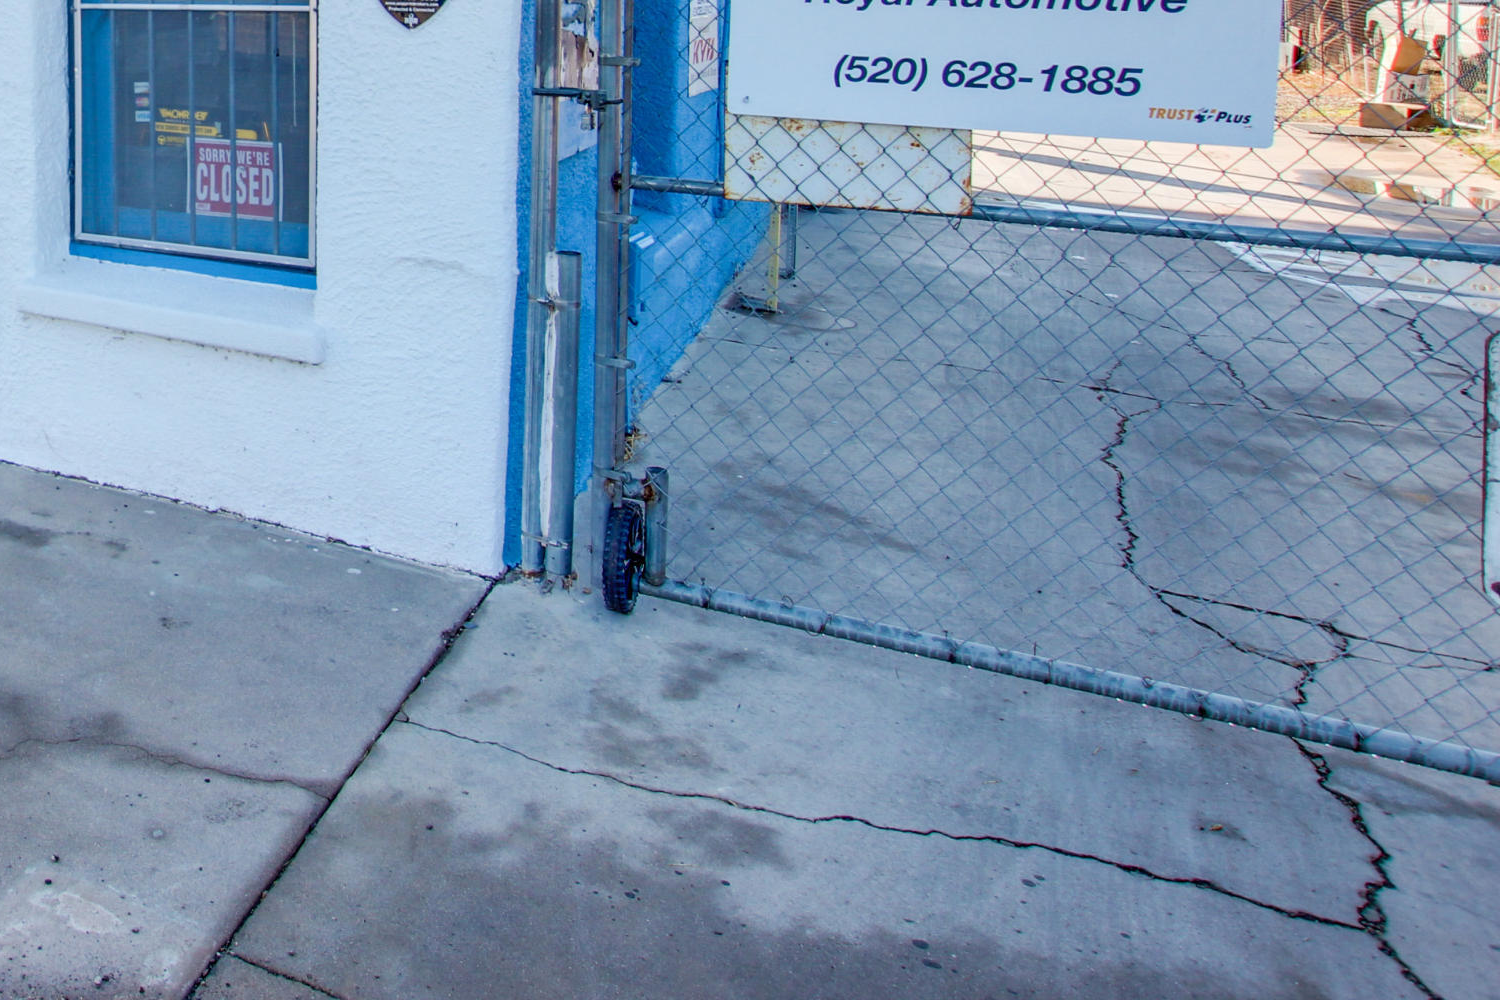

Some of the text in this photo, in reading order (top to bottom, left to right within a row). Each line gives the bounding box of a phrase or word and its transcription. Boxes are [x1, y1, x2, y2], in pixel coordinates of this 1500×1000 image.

[833, 54, 1144, 97] (520) 628-1885
[1148, 107, 1252, 125] TRUST PLUS
[199, 147, 271, 167] SORRY WE'RE
[196, 162, 274, 206] CLOSED
